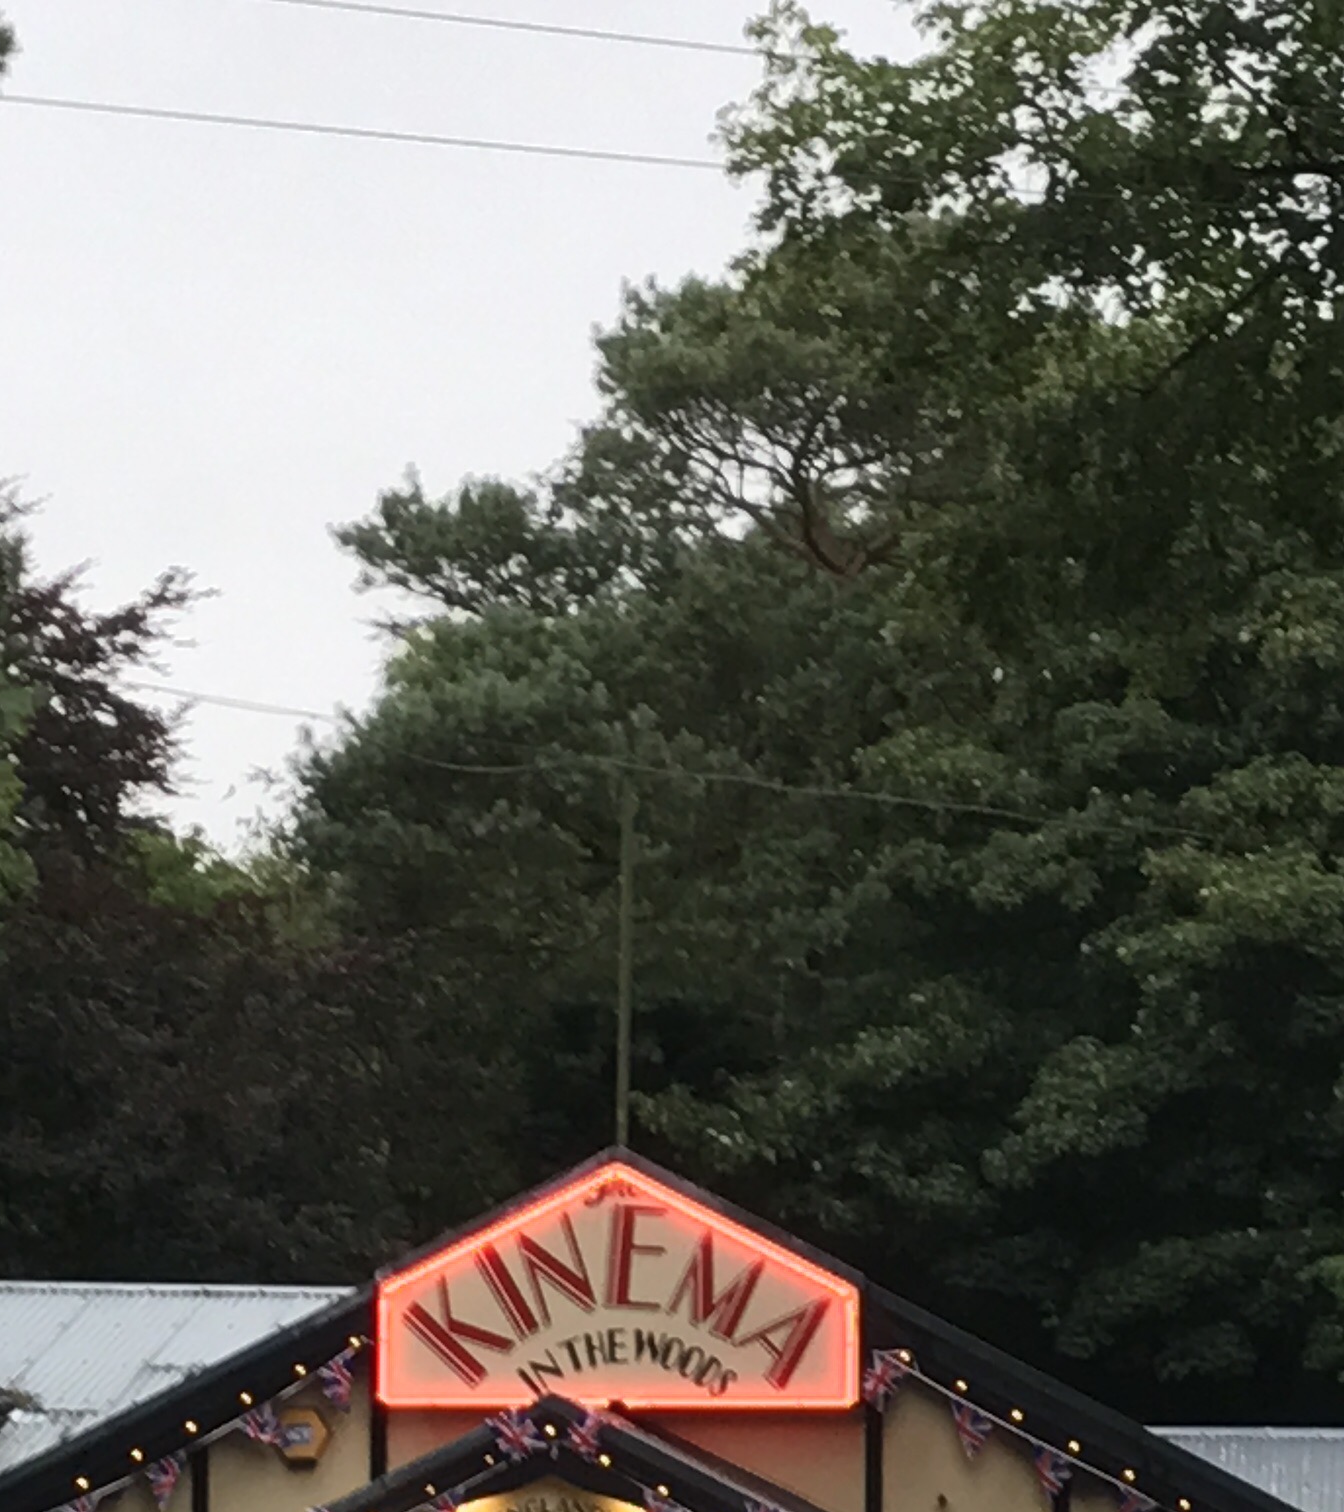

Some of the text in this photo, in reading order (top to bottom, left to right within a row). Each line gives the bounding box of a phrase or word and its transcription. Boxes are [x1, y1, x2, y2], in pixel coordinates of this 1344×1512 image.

[402, 1203, 832, 1391] KINEMA
[516, 1327, 739, 1397] IN THE WOODS
